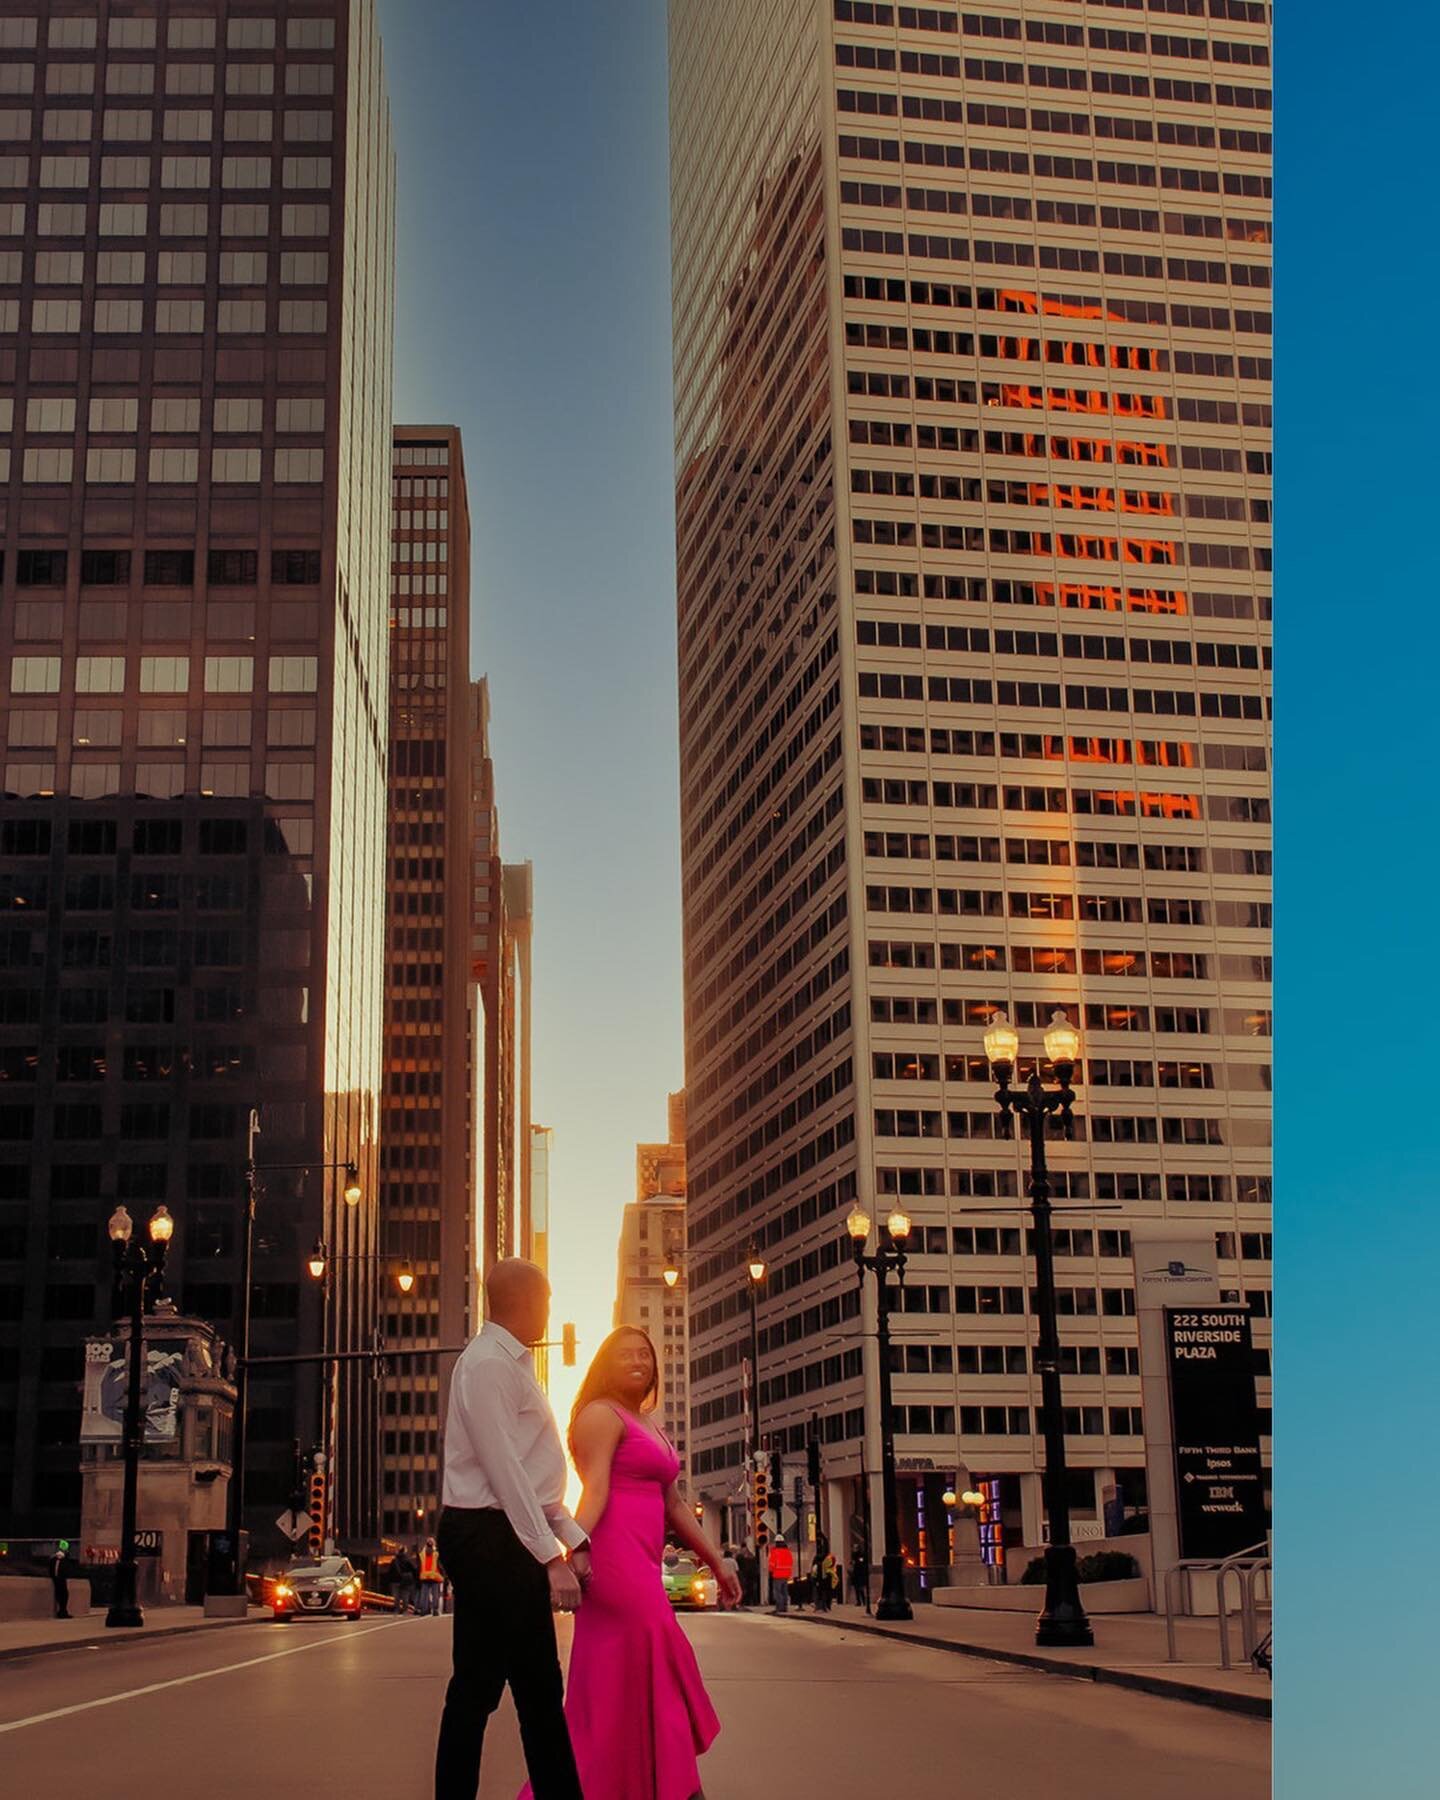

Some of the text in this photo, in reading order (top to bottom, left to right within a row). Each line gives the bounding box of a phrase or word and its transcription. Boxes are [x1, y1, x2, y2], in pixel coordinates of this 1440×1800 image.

[1173, 1314, 1246, 1327] 222 SOUTH
[1174, 1330, 1241, 1343] RIVERSIDE
[1175, 1346, 1217, 1359] PLAZA
[1178, 1446, 1258, 1454] FIFTH THIRD BANK
[1207, 1458, 1233, 1469] Ipsos
[1209, 1486, 1234, 1498] IBM
[1201, 1501, 1244, 1512] wework
